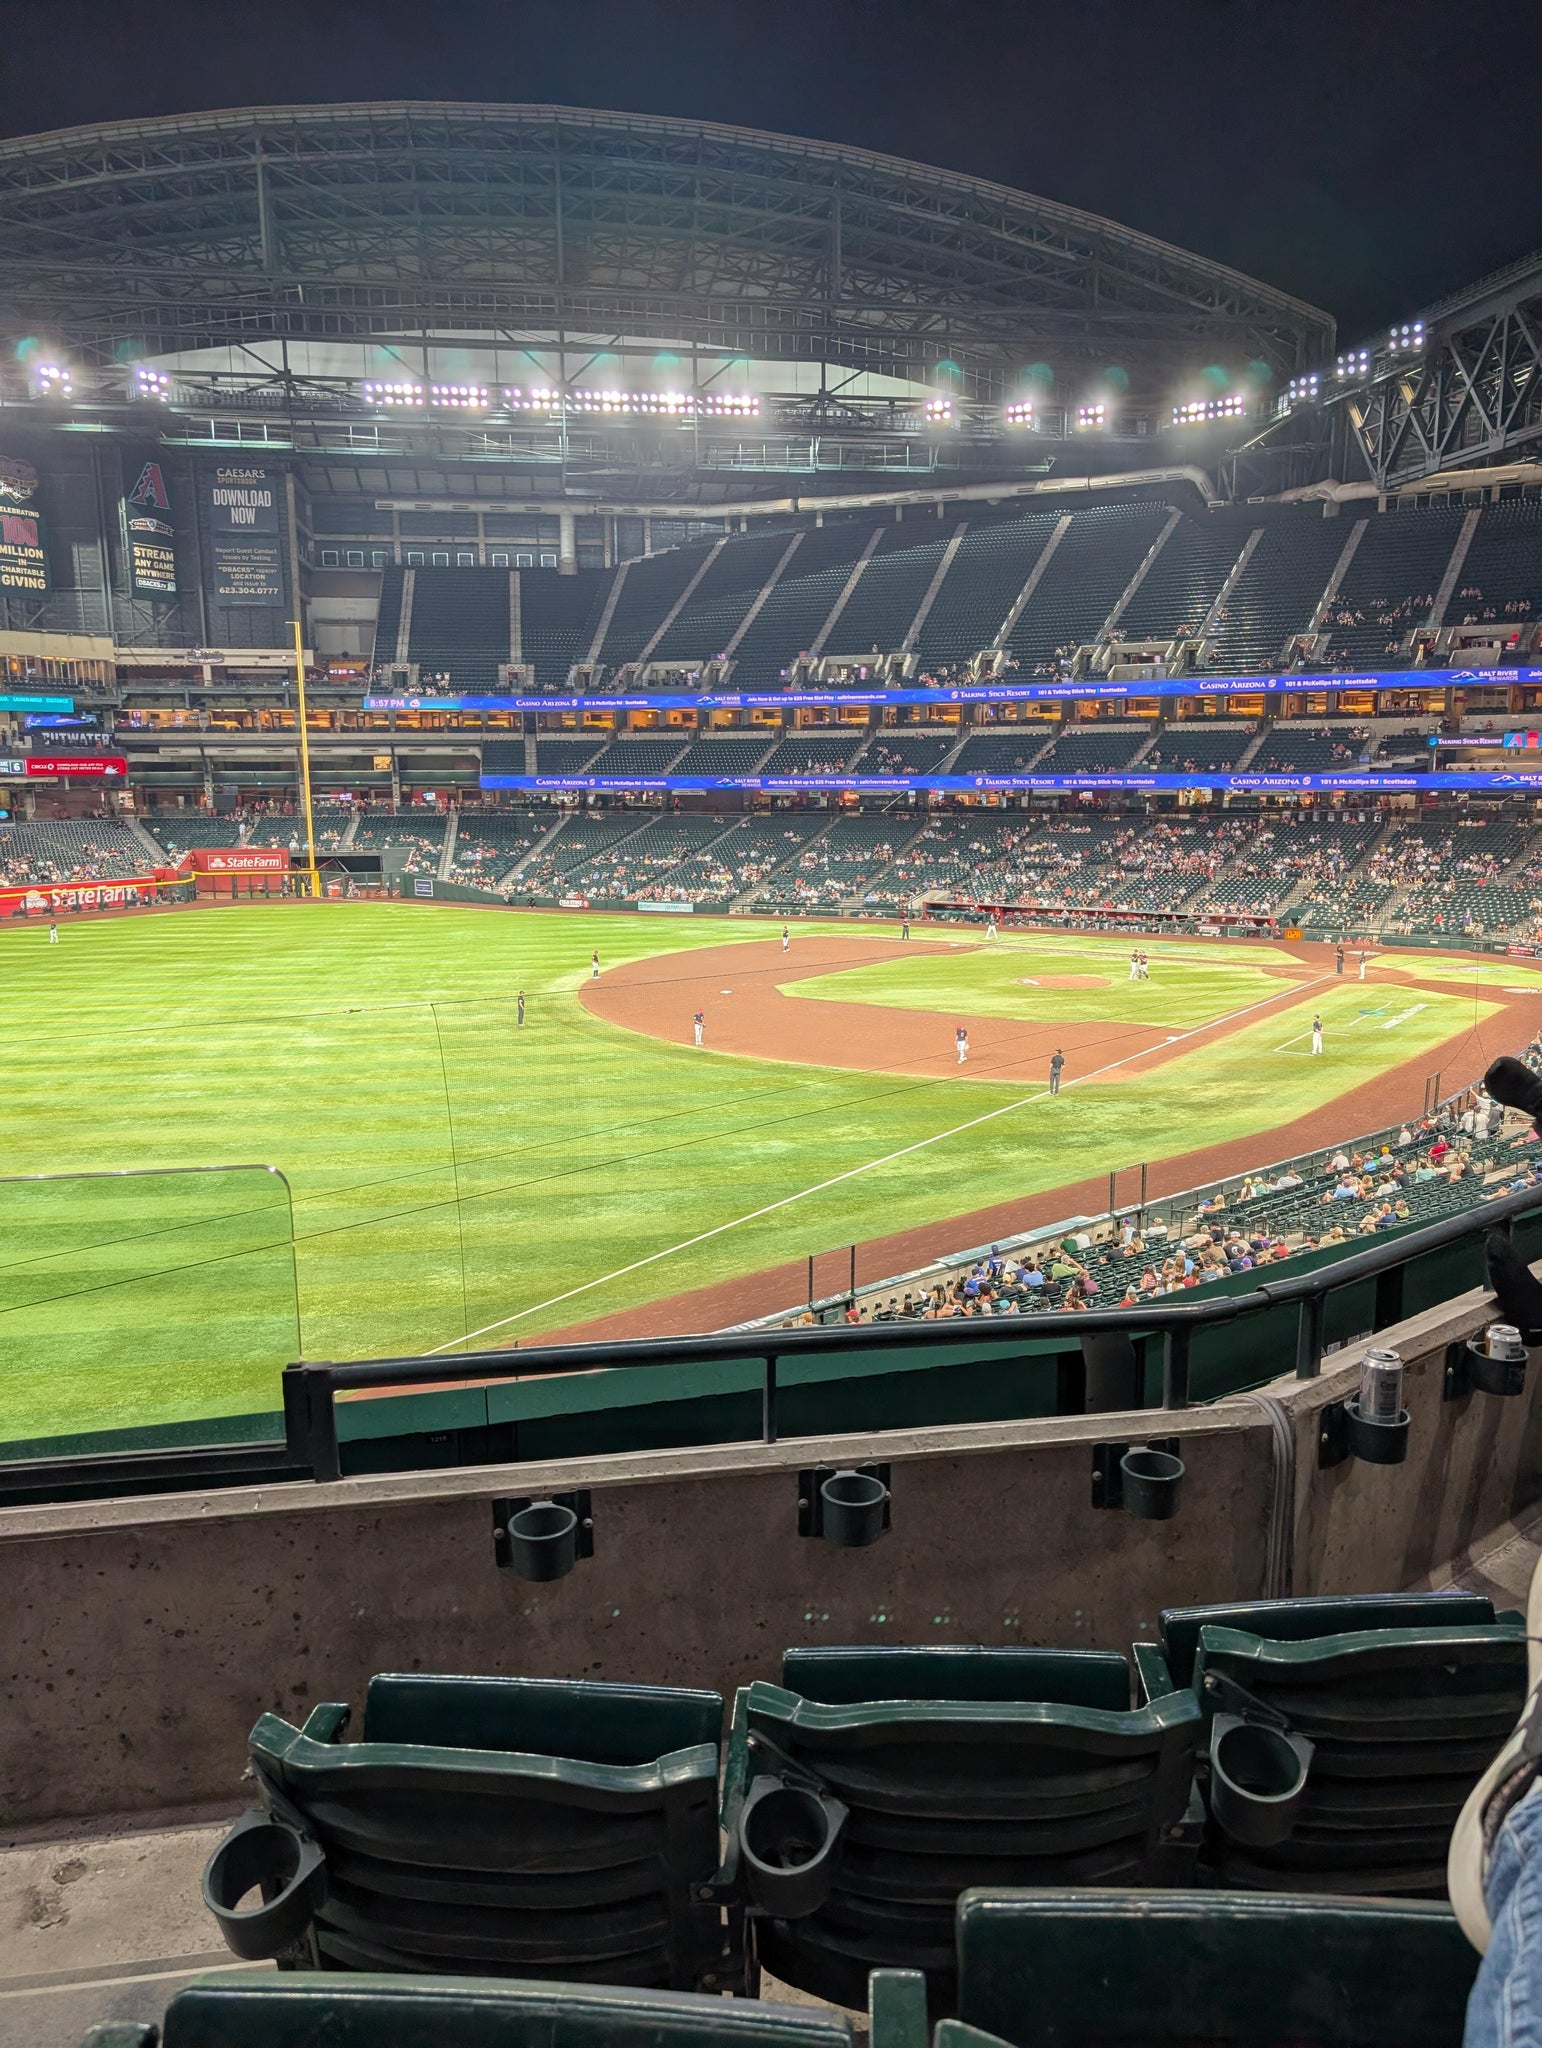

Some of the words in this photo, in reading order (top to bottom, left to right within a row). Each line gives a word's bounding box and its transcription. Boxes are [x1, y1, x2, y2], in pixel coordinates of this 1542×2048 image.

[216, 468, 266, 478] CAESARS
[213, 489, 272, 507] DOWNLOAD
[0, 506, 40, 518] ELEBRATING
[231, 507, 256, 524] NOW
[0, 544, 44, 559] MILLION
[133, 546, 174, 562] STREAM
[135, 558, 152, 568] ANY
[154, 562, 174, 571] GAME
[0, 566, 45, 577] CHARITABLE
[136, 568, 175, 580] ANYWHERE
[2, 575, 46, 590] GIVING
[220, 586, 278, 594] 623.304.0777
[1200, 681, 1228, 689] CASINO
[1230, 680, 1266, 688] ARIZONA
[390, 699, 404, 707] PM
[14, 762, 20, 771] 6
[1230, 777, 1260, 785] CASINO
[1262, 777, 1300, 785] ARIZONA
[226, 857, 252, 868] State
[253, 857, 280, 868] Farm
